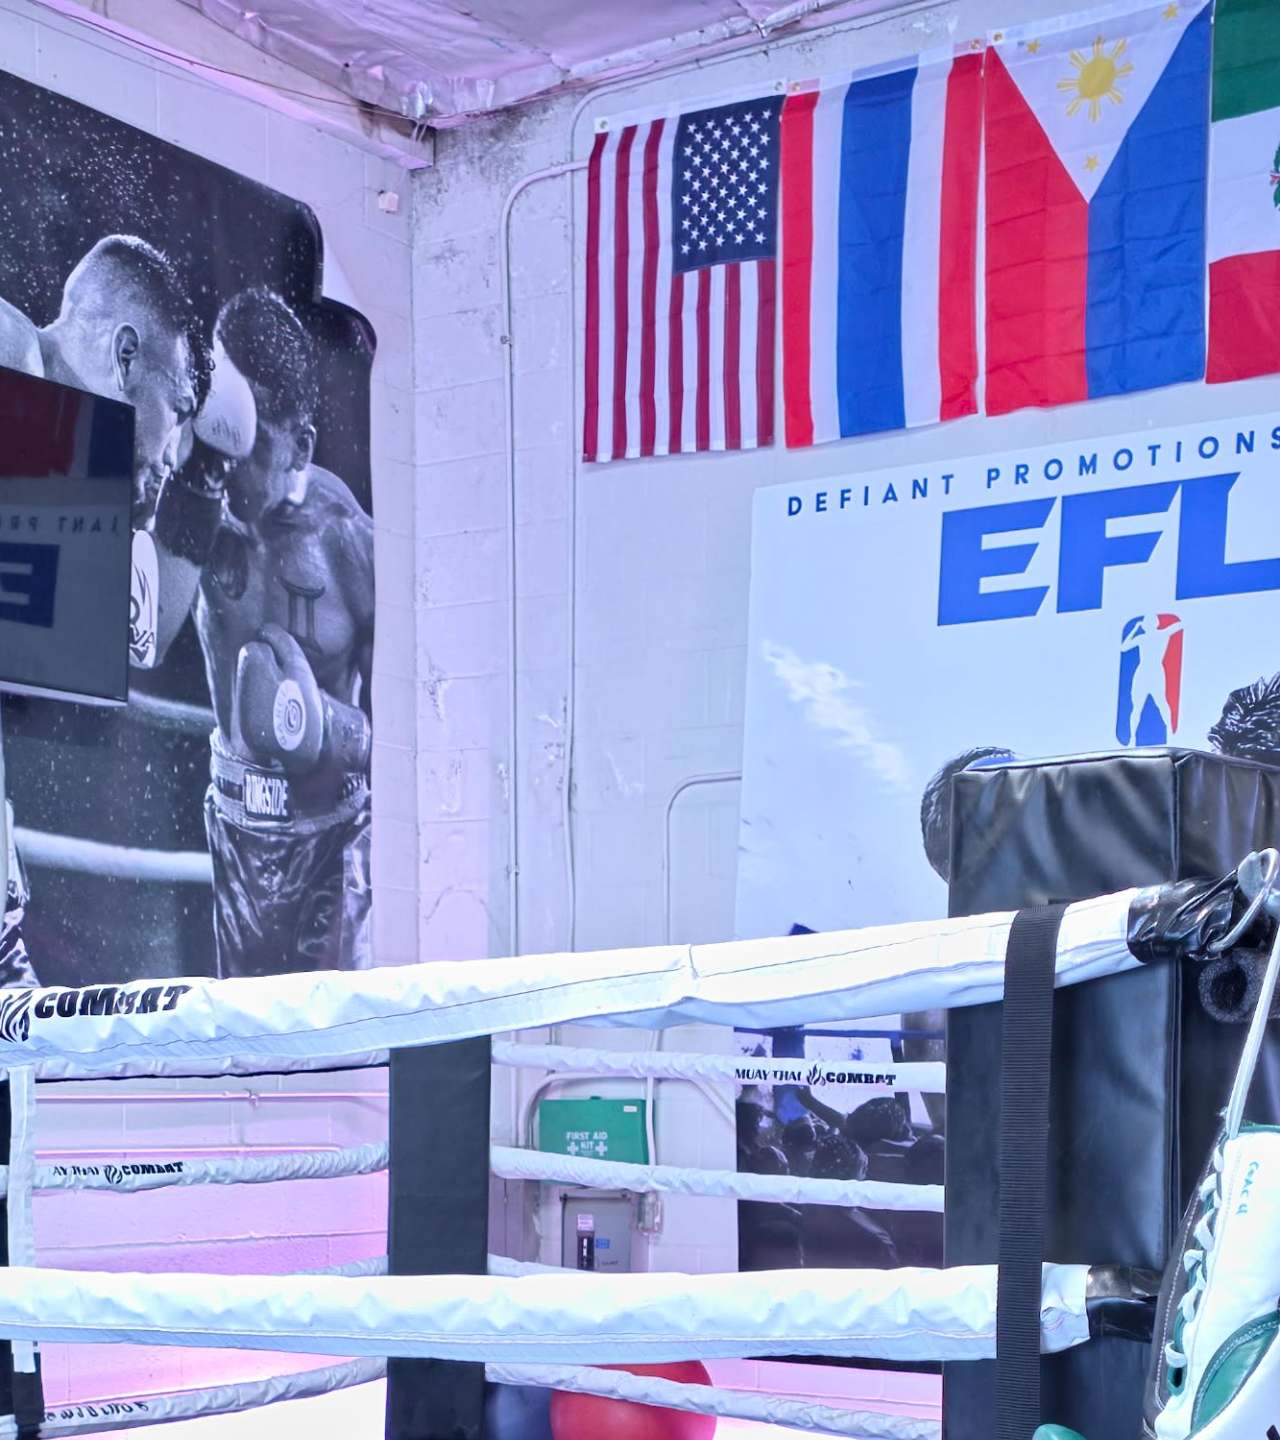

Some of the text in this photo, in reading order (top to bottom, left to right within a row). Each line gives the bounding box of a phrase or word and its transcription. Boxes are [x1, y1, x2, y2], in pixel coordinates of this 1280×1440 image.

[787, 473, 955, 516] DEFIANT
[35, 985, 192, 1018] COMBAT
[735, 1068, 897, 1086] MUAY THAI COMBAT
